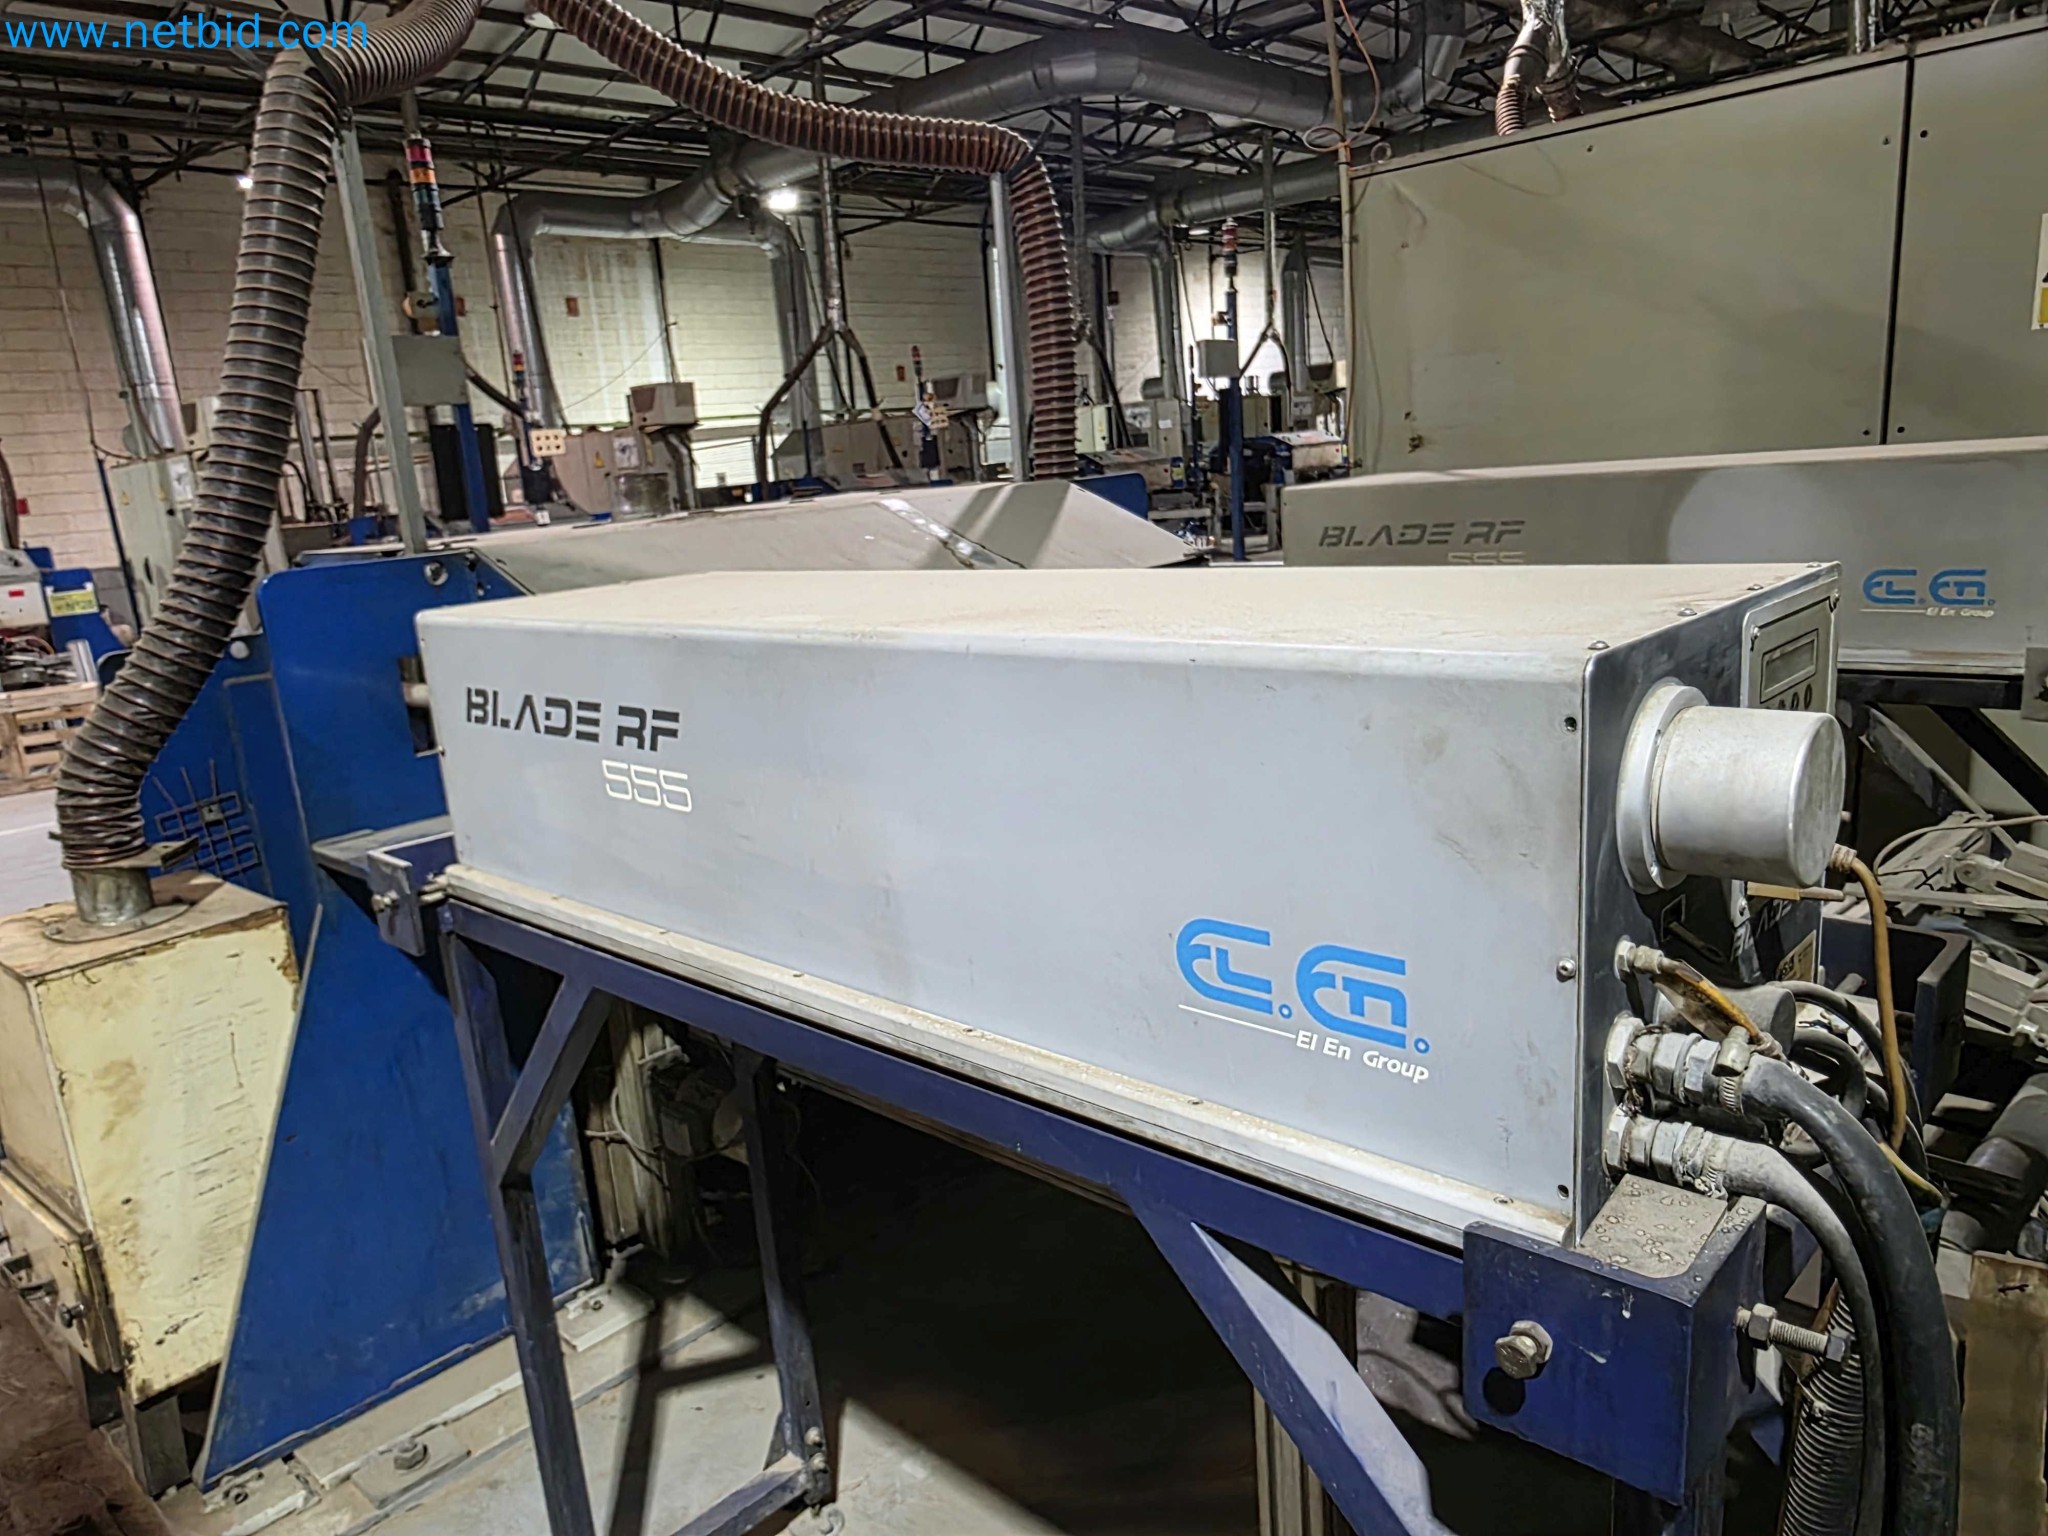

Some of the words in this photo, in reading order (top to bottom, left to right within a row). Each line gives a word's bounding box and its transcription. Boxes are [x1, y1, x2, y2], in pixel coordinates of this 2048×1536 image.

[1319, 523, 1455, 547] BLADE
[1464, 520, 1526, 545] RF
[466, 687, 601, 743] BLADE
[616, 705, 680, 752] RF
[602, 759, 692, 812] 555
[1296, 1030, 1317, 1051] El
[1322, 1037, 1351, 1061] En
[1362, 1050, 1429, 1083] Group
